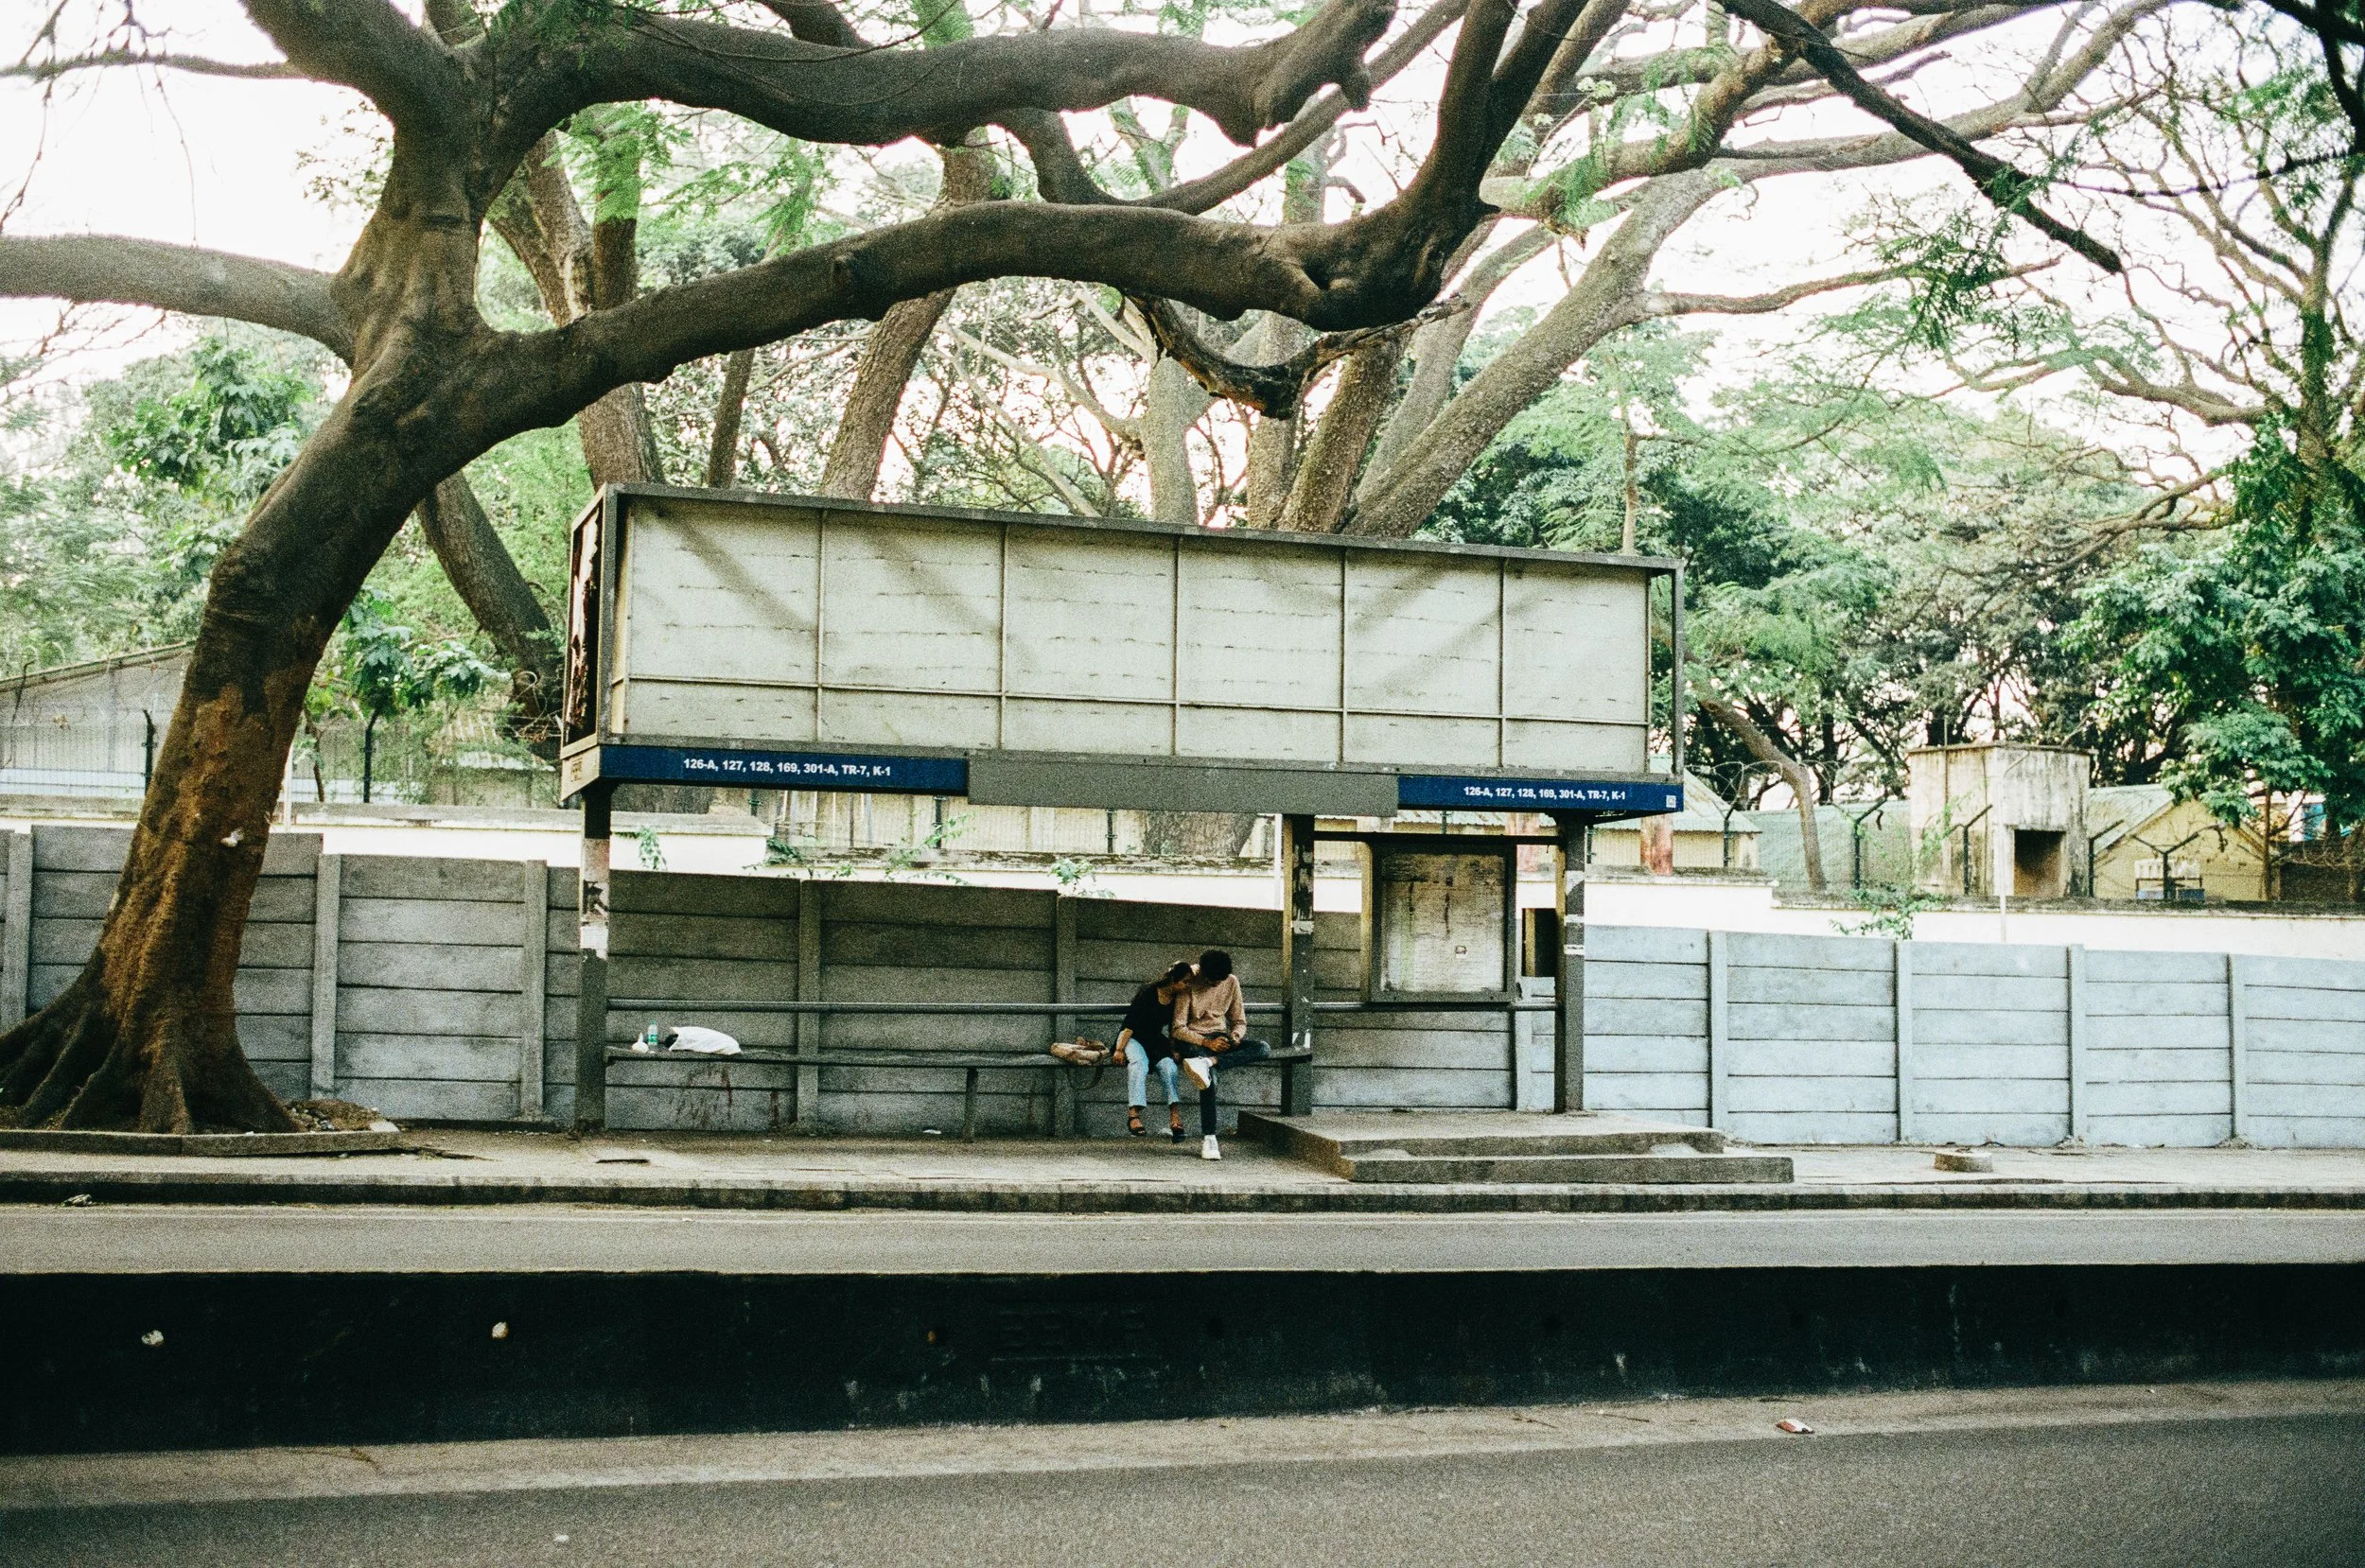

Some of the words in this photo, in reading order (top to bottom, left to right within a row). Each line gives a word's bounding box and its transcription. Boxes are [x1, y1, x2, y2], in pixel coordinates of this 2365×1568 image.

[683, 758, 719, 772] 126-A,
[722, 760, 746, 773] 127,
[749, 761, 774, 774] 128,
[777, 762, 801, 775] 169,
[803, 763, 839, 775] 301-A,
[841, 765, 870, 777] TR-7,
[872, 766, 891, 776] K-1
[1463, 787, 1494, 798] 126-A,
[1495, 788, 1515, 799] 127,
[1516, 789, 1537, 799] 128,
[1538, 789, 1557, 800] 169,
[1559, 790, 1586, 801] 301-A,
[1587, 791, 1610, 801] TR-7,
[1611, 791, 1626, 800] K-1
